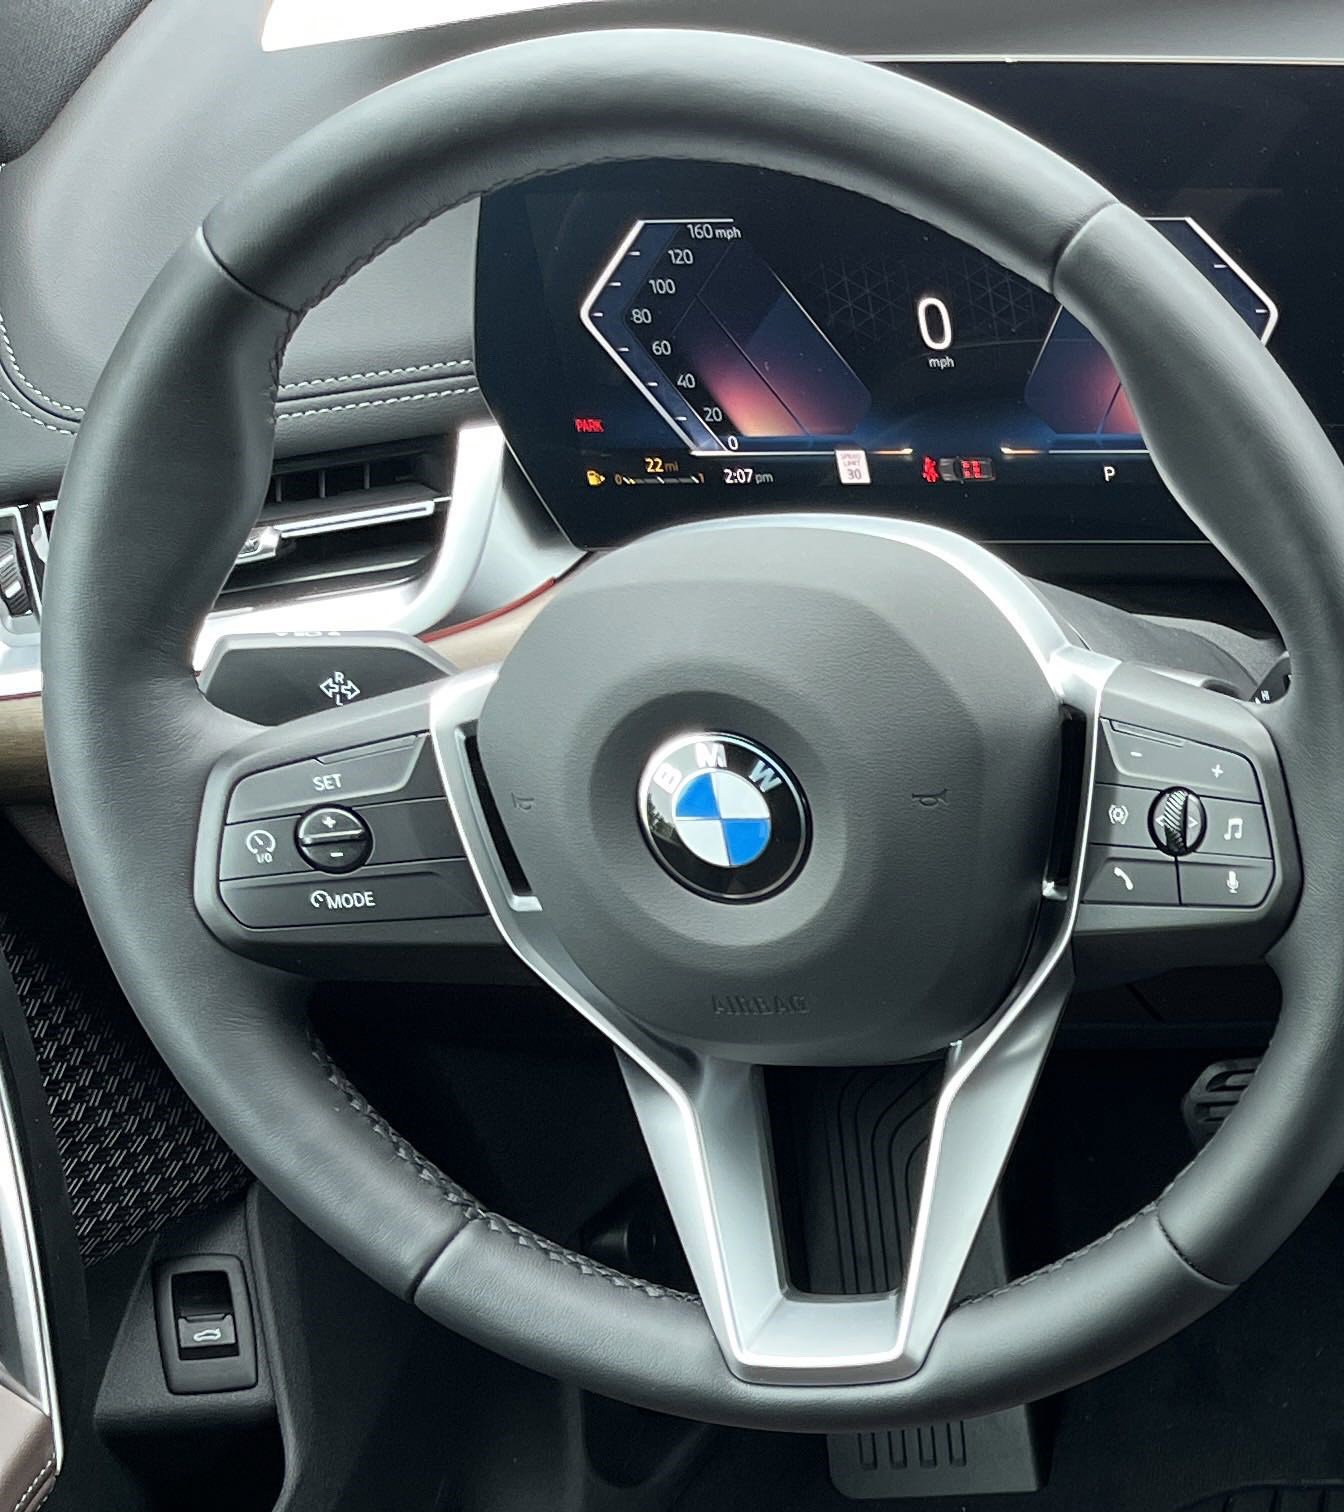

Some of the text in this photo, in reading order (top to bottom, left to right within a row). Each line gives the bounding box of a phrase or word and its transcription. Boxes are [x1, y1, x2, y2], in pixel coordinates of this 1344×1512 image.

[687, 224, 742, 241] 160 mph
[668, 249, 694, 264] 120
[649, 279, 676, 294] 100
[632, 309, 652, 324] 80
[917, 297, 952, 350] 0
[652, 341, 671, 355] 60
[928, 356, 955, 369] mph
[677, 374, 696, 389] 40
[703, 407, 722, 422] 20
[575, 418, 604, 433] PARK
[728, 435, 739, 451] 0
[645, 458, 664, 473] 22
[724, 469, 774, 485] 2:07 pm
[848, 469, 862, 480] 30
[1103, 466, 1116, 481] P
[653, 742, 782, 793] BMW
[312, 774, 342, 791] SET
[327, 891, 376, 909] MODE
[711, 994, 809, 1016] AIRBAG
